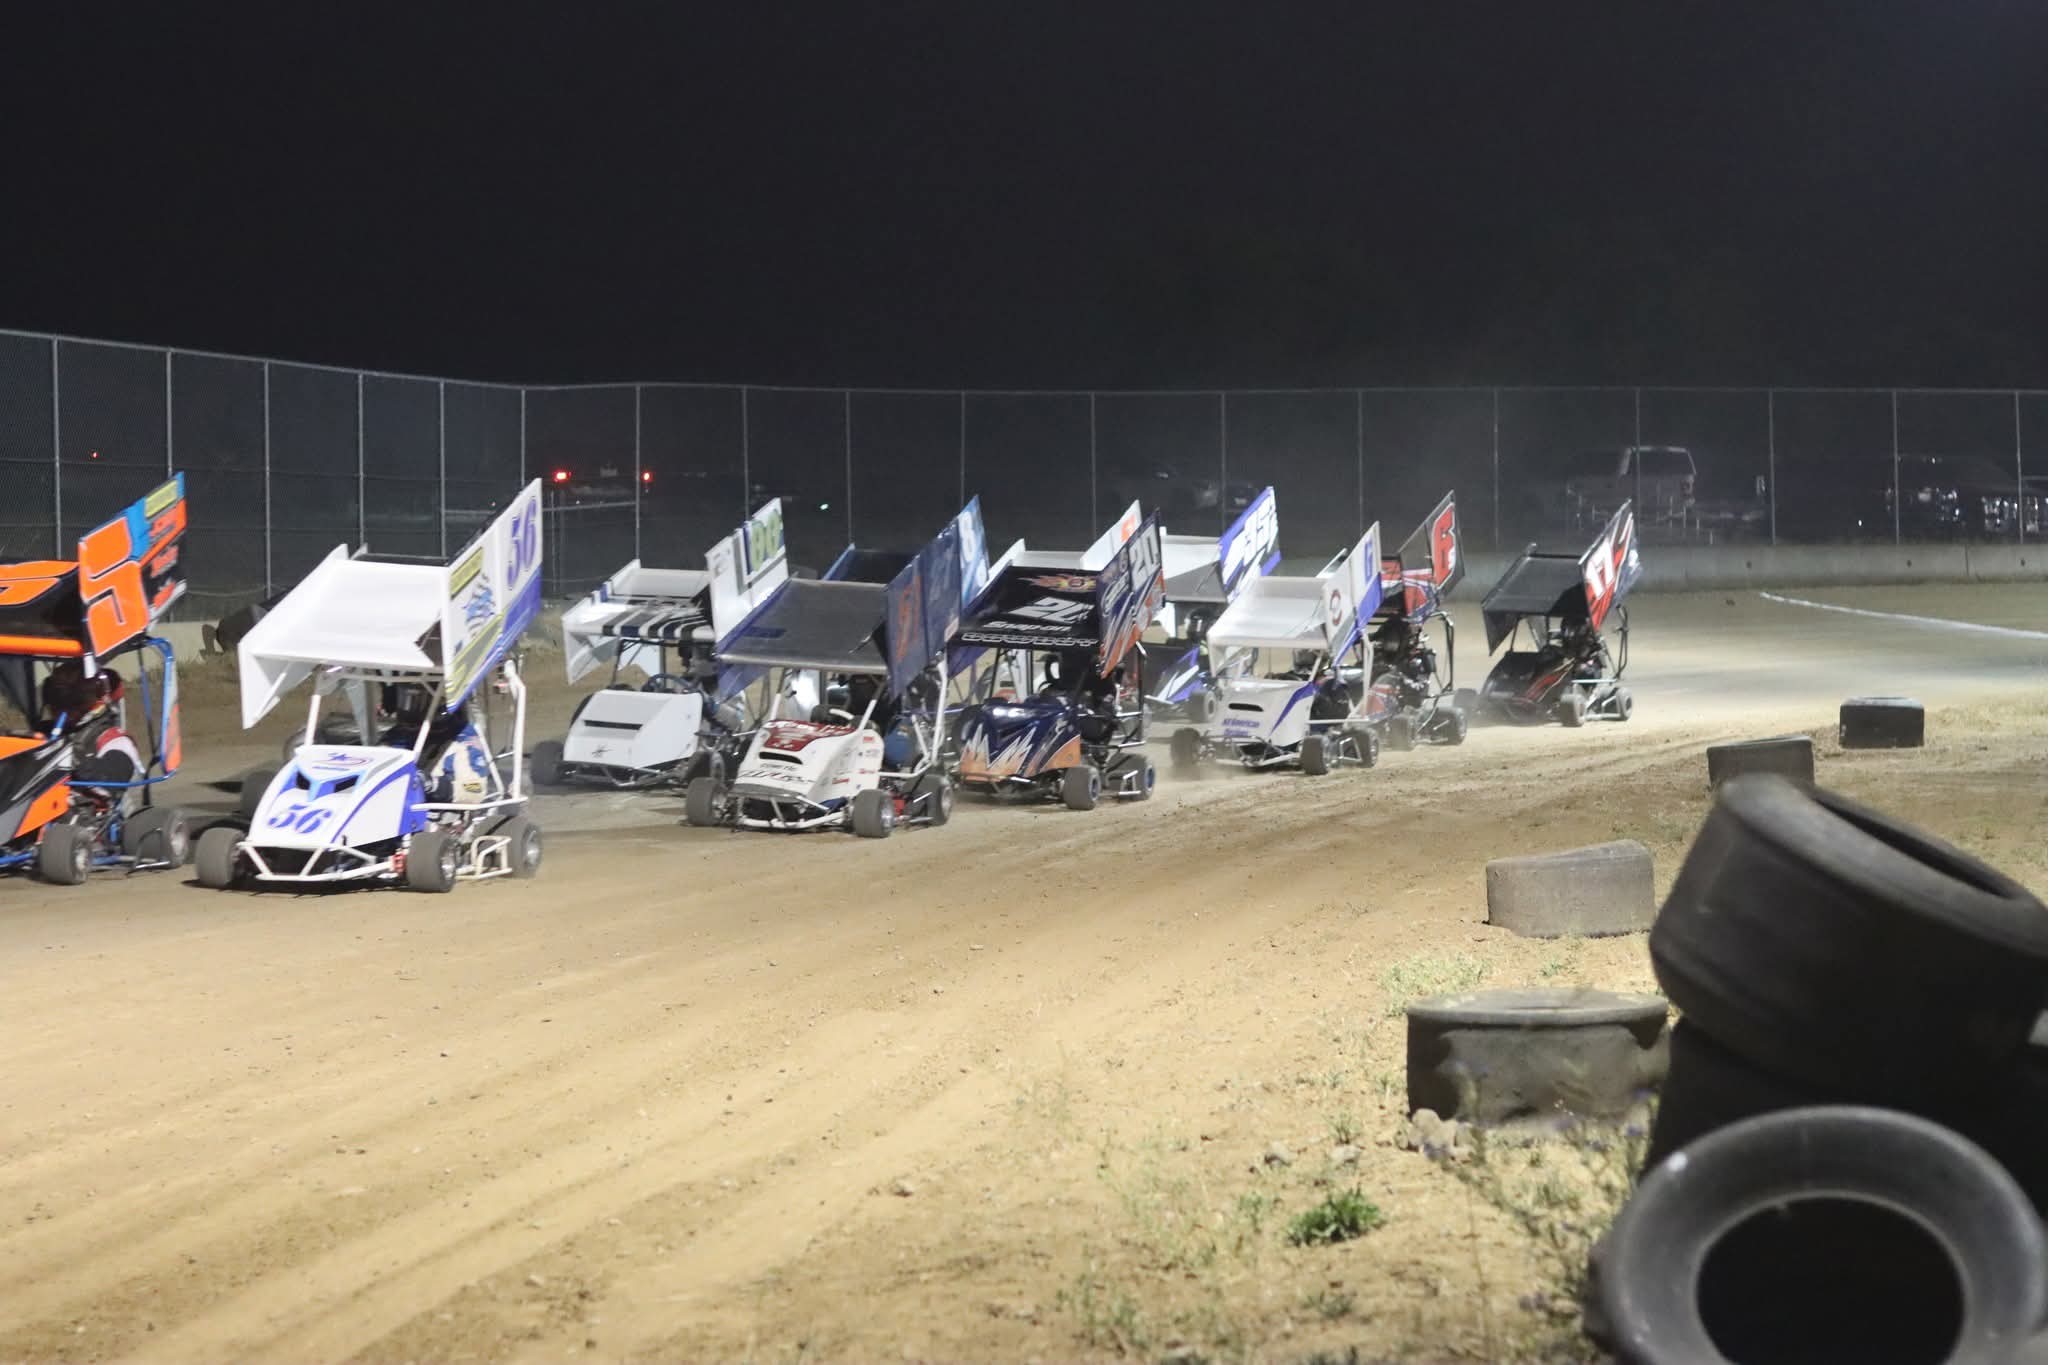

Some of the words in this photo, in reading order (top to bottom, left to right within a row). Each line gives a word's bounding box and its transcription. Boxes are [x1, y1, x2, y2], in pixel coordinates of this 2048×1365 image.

[79, 516, 151, 657] 5
[507, 497, 538, 592] 56
[1431, 503, 1457, 589] 6
[268, 803, 332, 834] 56
